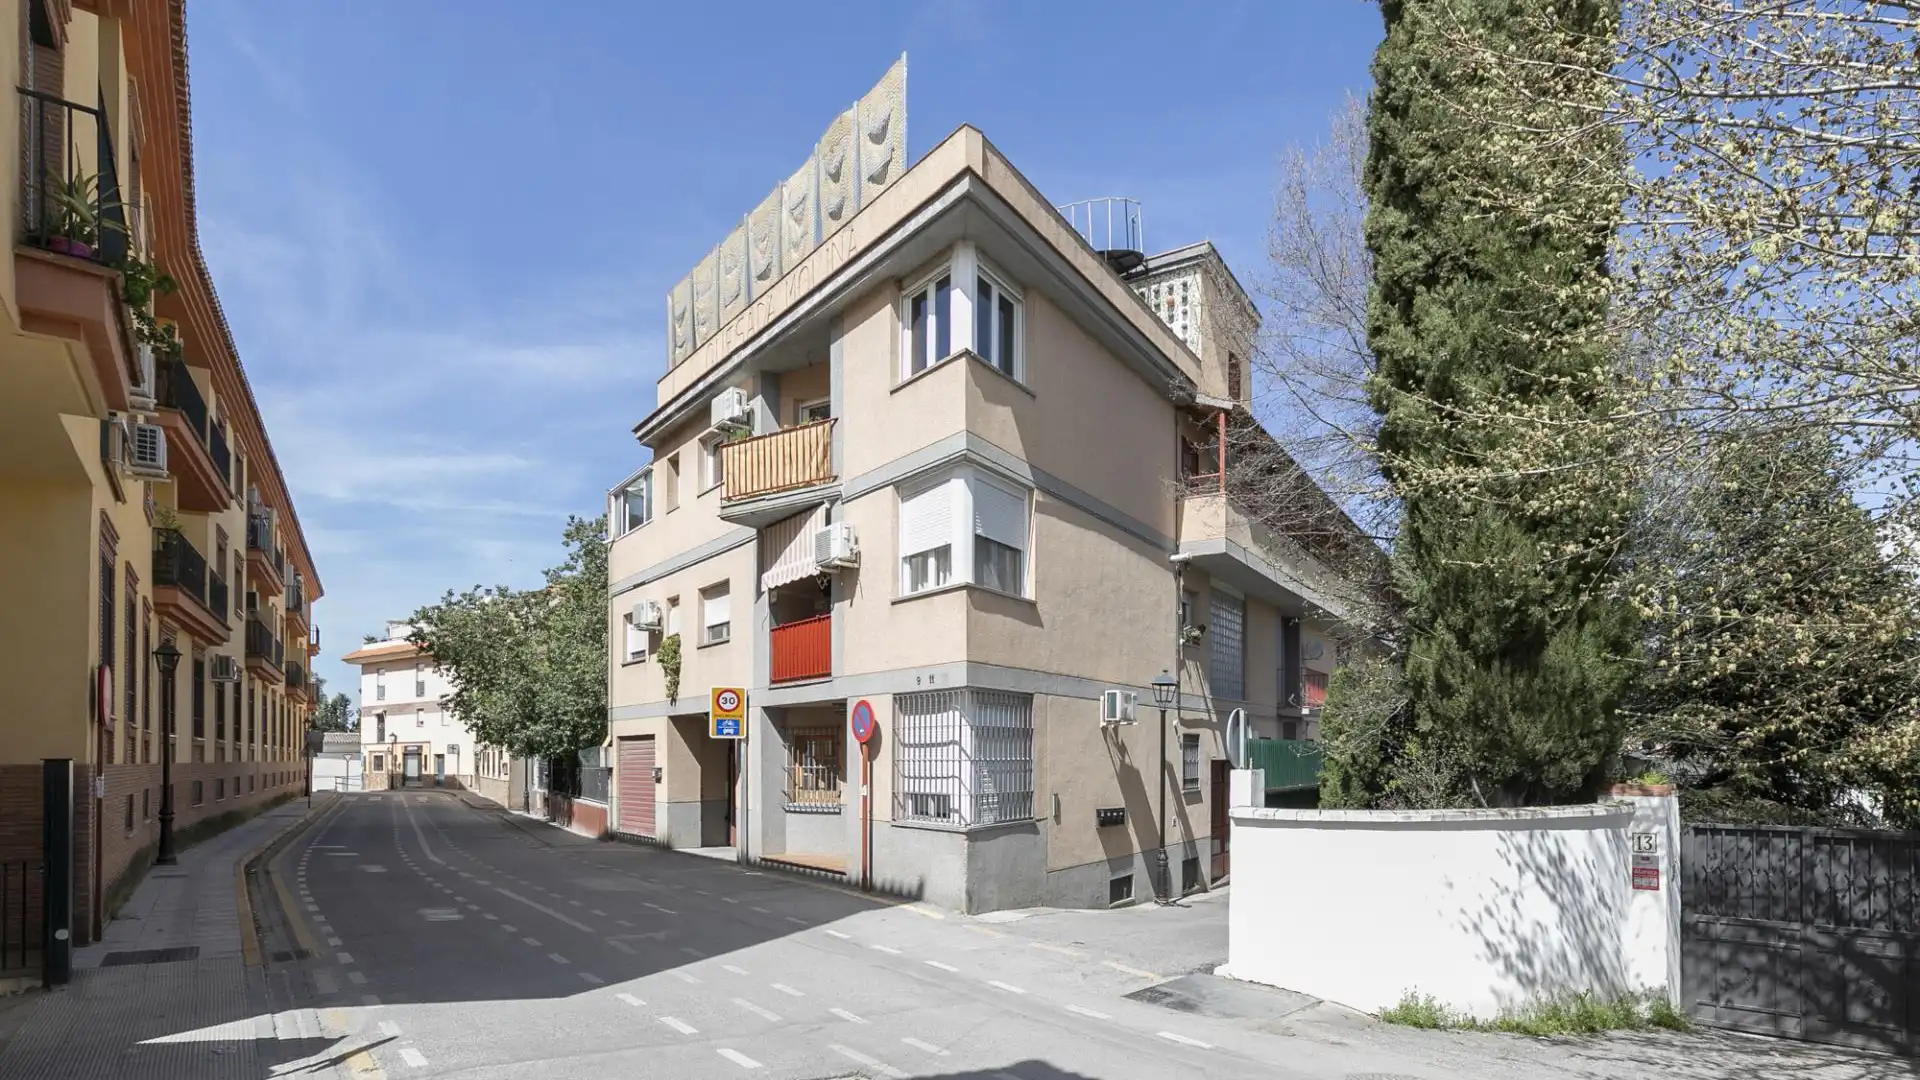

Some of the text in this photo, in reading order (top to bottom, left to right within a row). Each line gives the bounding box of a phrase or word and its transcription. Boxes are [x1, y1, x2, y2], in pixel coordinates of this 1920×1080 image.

[916, 676, 921, 686] 9
[721, 696, 736, 705] 30
[1636, 835, 1653, 851] 13
